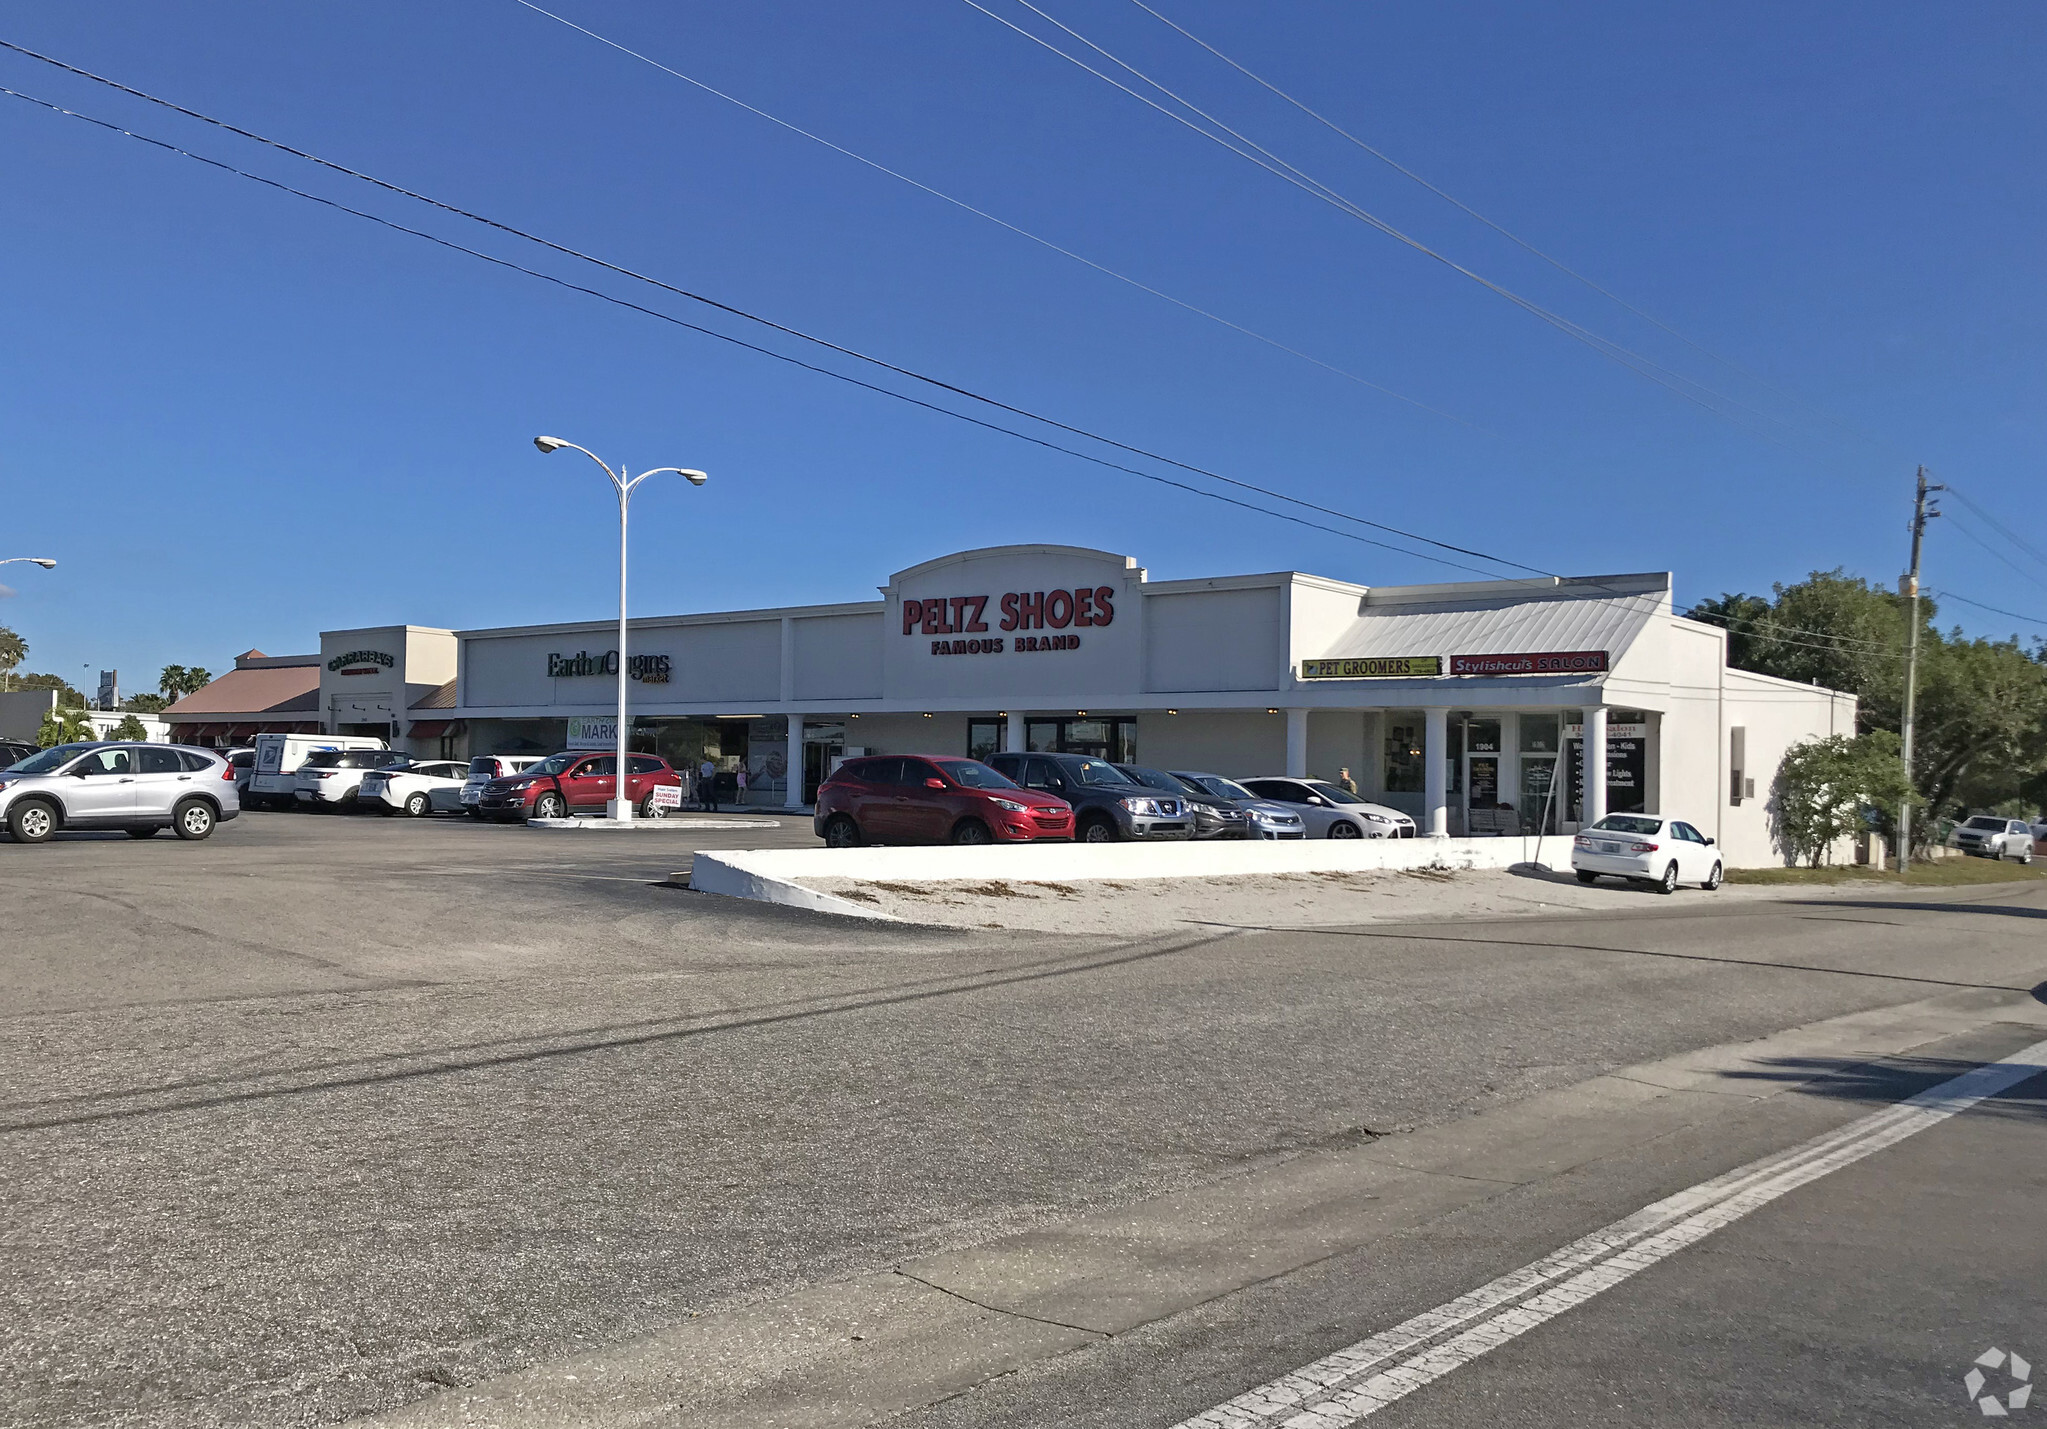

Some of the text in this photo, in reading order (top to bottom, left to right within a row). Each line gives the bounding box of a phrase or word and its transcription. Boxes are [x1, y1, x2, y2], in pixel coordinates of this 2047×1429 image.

[902, 586, 1114, 635] PELTZ SHOES
[931, 635, 1081, 655] FAMOUS BRAND
[547, 650, 594, 677] Earth
[1319, 659, 1411, 675] PET GROOMERS
[1455, 656, 1600, 672] Stylishcuts SALON
[1620, 741, 1636, 750] Kids
[1612, 769, 1632, 778] Lights
